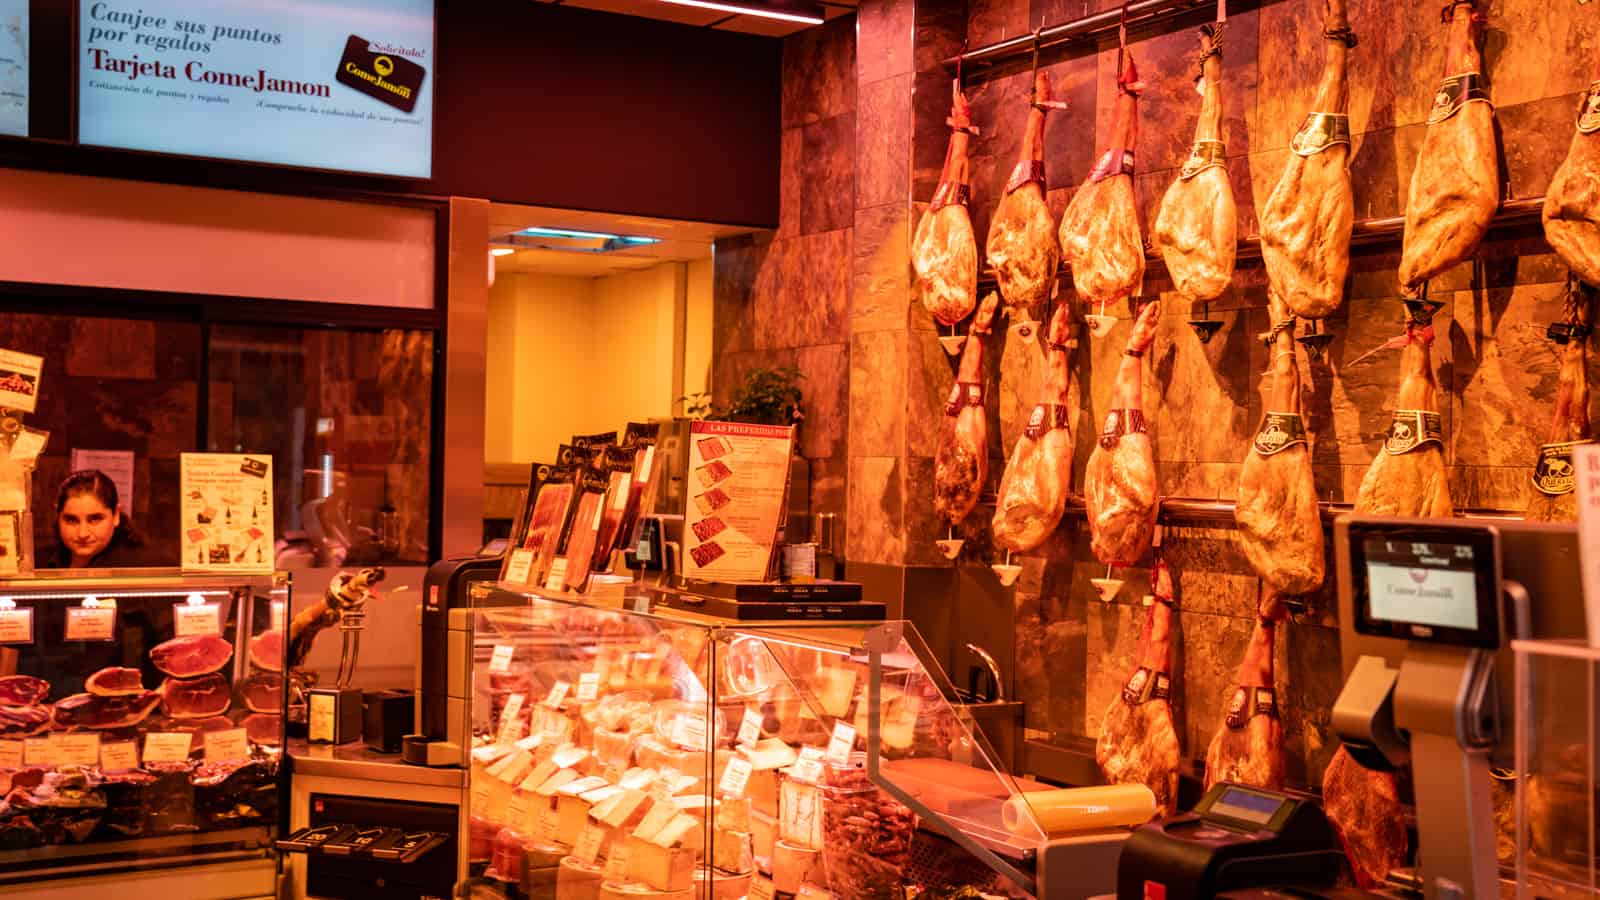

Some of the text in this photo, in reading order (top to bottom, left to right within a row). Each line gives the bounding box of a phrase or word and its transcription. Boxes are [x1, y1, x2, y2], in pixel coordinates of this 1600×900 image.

[88, 27, 211, 53] por regalos
[90, 2, 281, 44] Canjee sus puntos
[87, 48, 331, 97] Tarjeta ComeJamon
